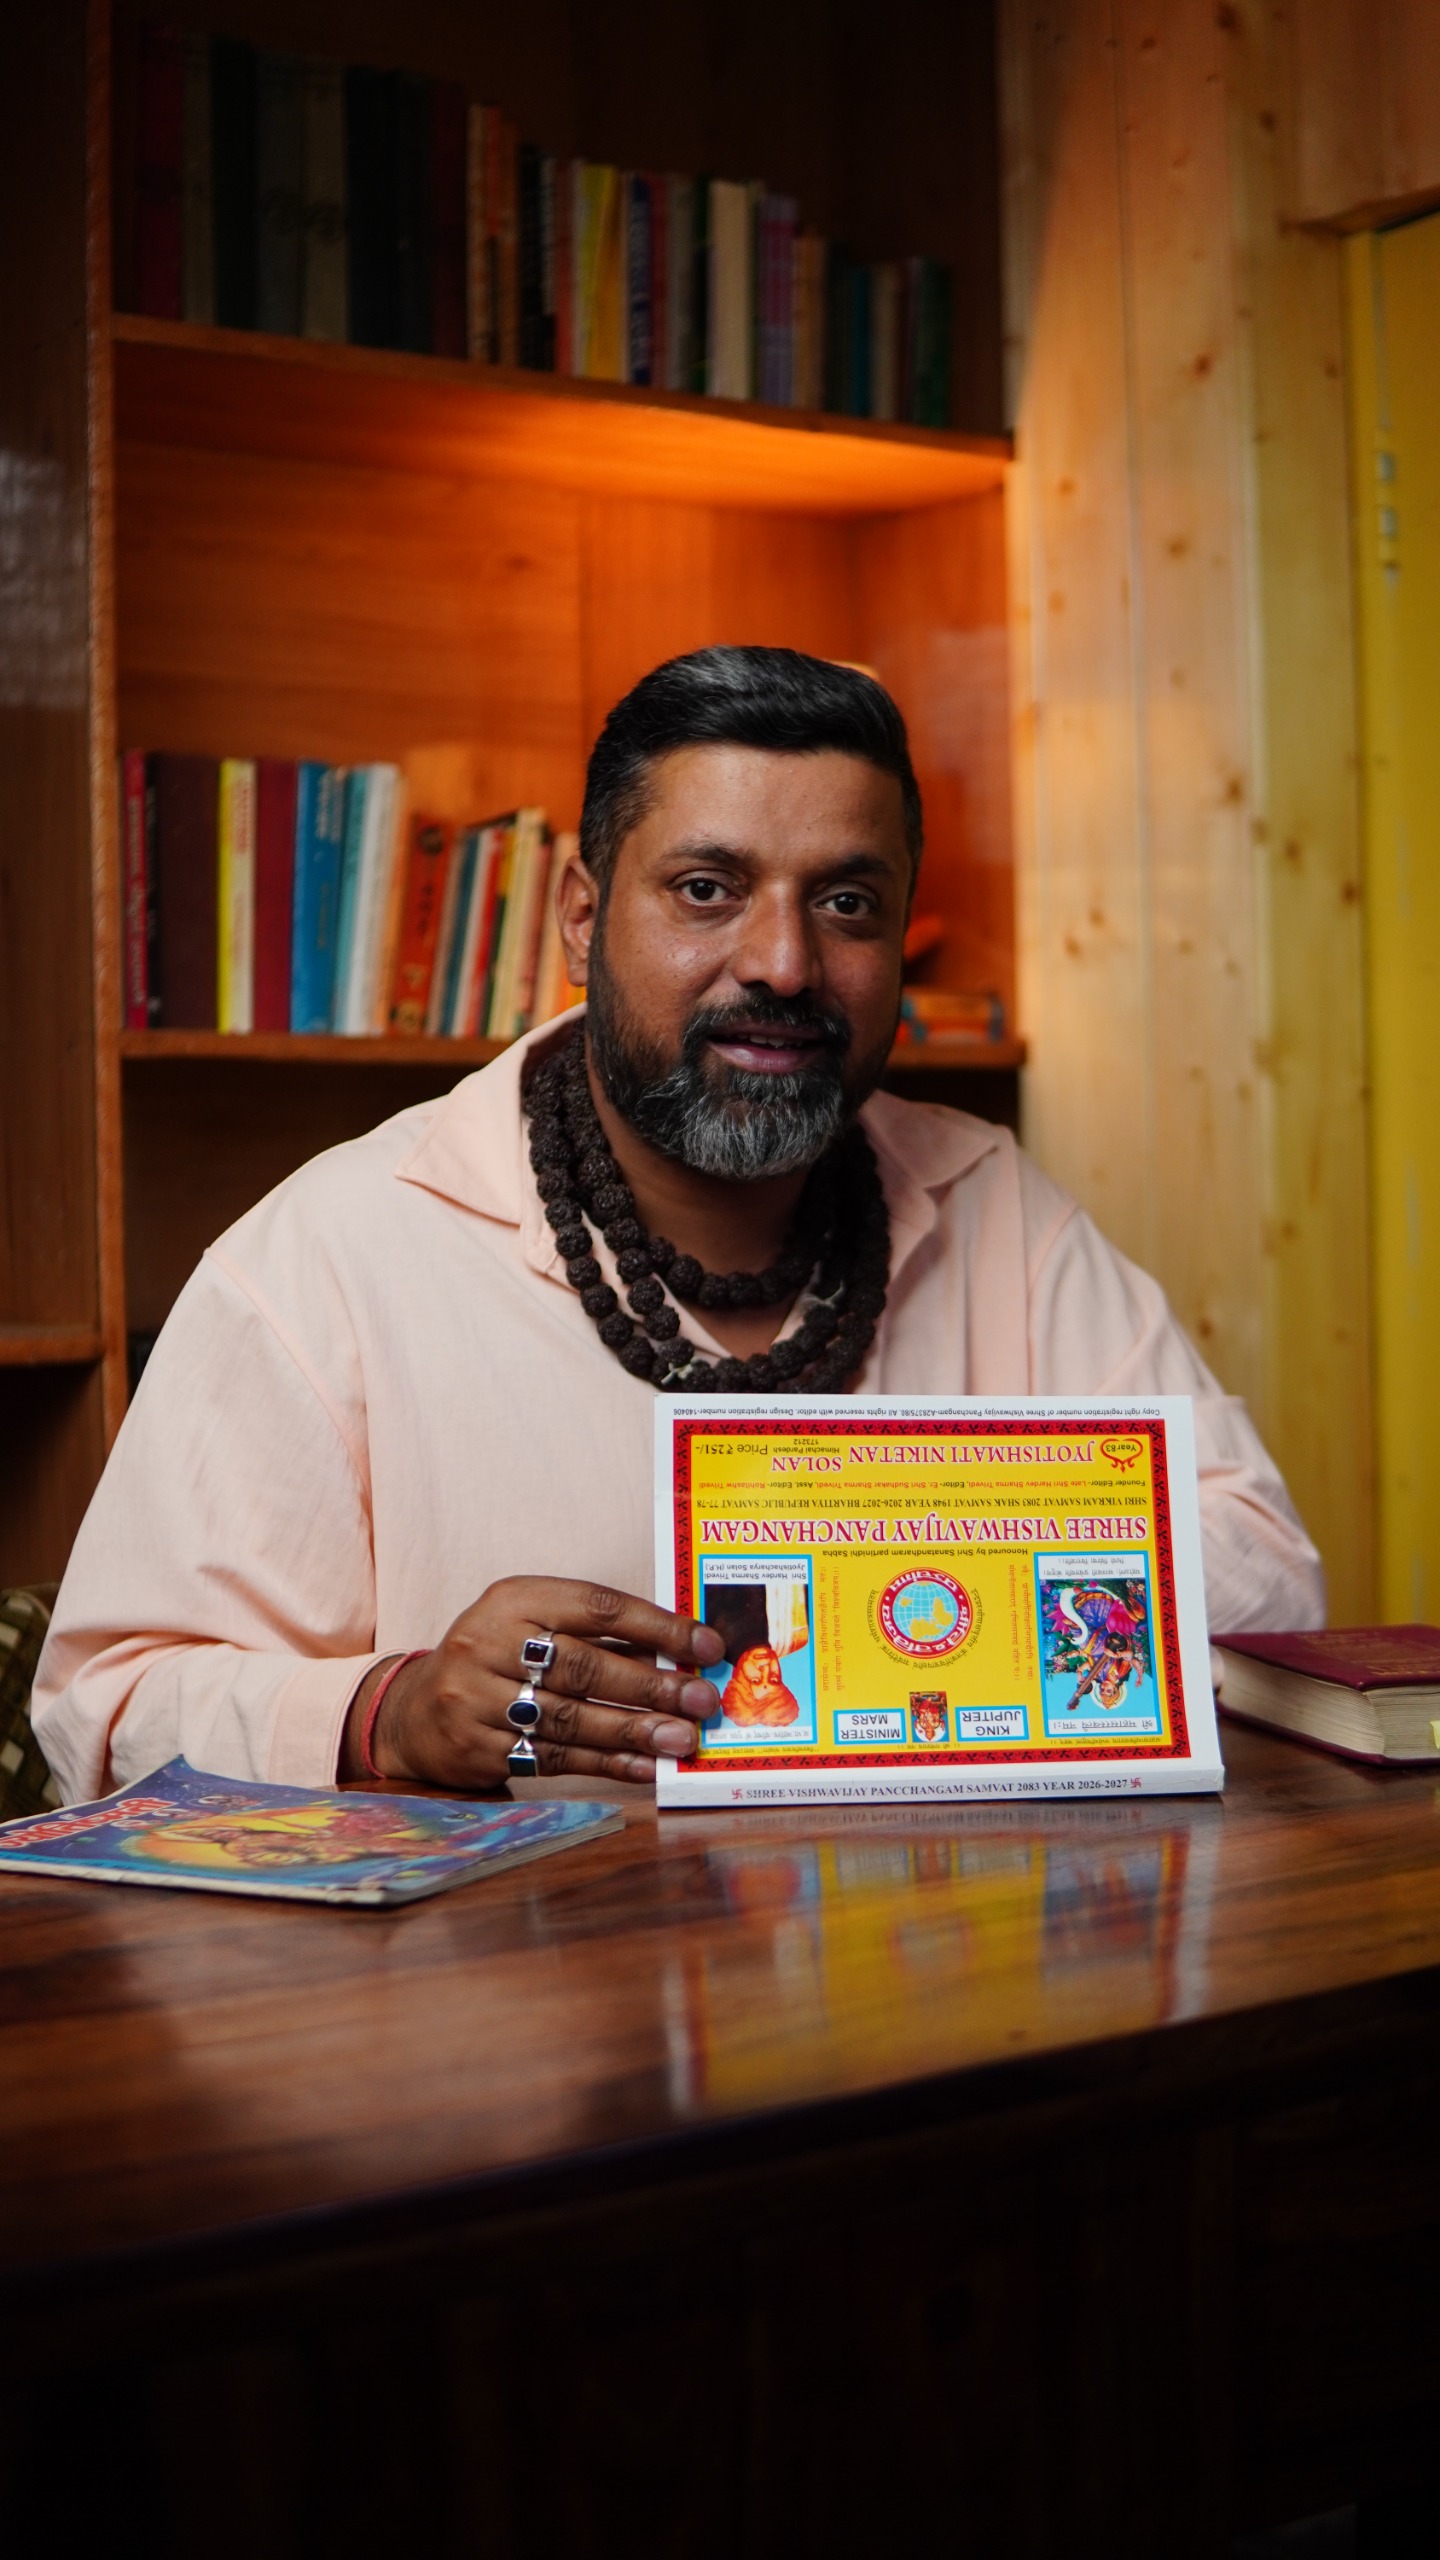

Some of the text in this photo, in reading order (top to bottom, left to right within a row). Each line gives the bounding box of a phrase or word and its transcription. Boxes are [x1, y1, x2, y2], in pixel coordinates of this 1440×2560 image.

[727, 1407, 768, 1415] registration
[769, 1407, 794, 1415] Design
[866, 1408, 887, 1416] rights
[983, 1408, 1024, 1417] Vishwavijay
[1025, 1409, 1046, 1417] Shree
[1083, 1408, 1123, 1416] registration
[1124, 1408, 1141, 1416] right
[1142, 1408, 1160, 1416] Copy
[737, 1444, 768, 1455] Price
[848, 1440, 1095, 1463] JYOTISHMATI NIKETAN
[1105, 1444, 1136, 1453] Year 83
[771, 1456, 842, 1472] SOLAN
[767, 1481, 792, 1489] Editor-
[795, 1481, 813, 1489] Asst.
[815, 1481, 842, 1489] Trivedi,
[844, 1481, 872, 1489] Sharma
[874, 1481, 909, 1489] Sudhakar
[911, 1481, 926, 1489] Shri
[939, 1481, 965, 1489] Editor-
[966, 1480, 993, 1488] Trivedi,
[1025, 1480, 1052, 1488] Hardev
[1053, 1480, 1069, 1488] Shri
[696, 1497, 1147, 1509] SHRI VIKRAM SAMVAT 2083 SHAK SAMVAT 1948 YEAR 2026-2027 BHARTIYA REPUBLIC SAMVAT 77-78
[701, 1512, 1147, 1544] SHREE VISHWAVIJAY PANCHANGAM
[822, 1547, 1028, 1558] Honoured by Shri Sanatandharam partinidhi Sabha
[705, 1563, 725, 1572] (H.P.)
[749, 1563, 805, 1571] Jyotishacharya
[761, 1572, 788, 1580] Hardev
[791, 1572, 806, 1580] Shri
[851, 1714, 888, 1725] MARS
[961, 1710, 1021, 1722] JUPITER
[1141, 1719, 1154, 1731] श्री
[840, 1728, 900, 1740] MINISTER
[975, 1725, 1010, 1736] KING
[746, 1779, 1128, 1799] SHREE VISHWAVIJAY PANCCHANGAM SAMVAT 2083 YEAR 2026-2027
